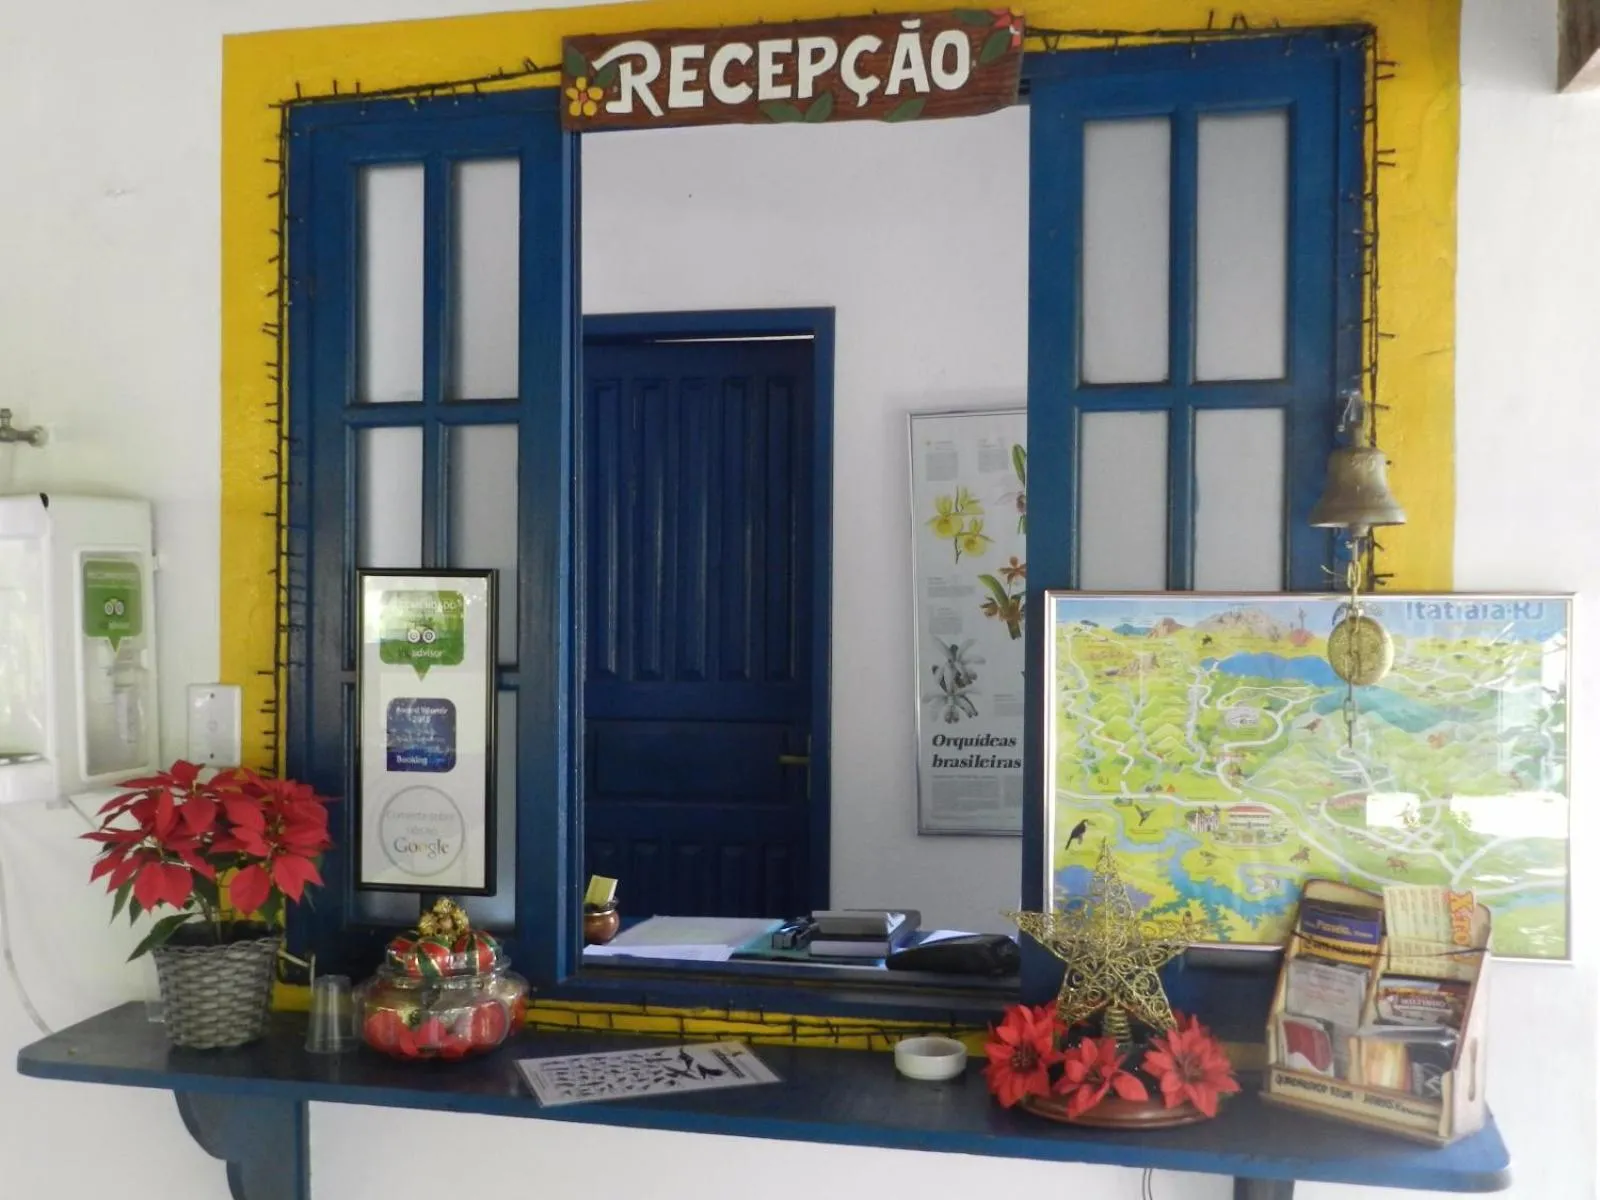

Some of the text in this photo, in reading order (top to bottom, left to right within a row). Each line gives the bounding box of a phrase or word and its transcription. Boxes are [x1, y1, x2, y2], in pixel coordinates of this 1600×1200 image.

[592, 18, 972, 117] RECEPÇÃO
[931, 734, 1017, 751] Orquídeas
[931, 754, 1022, 769] brasileiras
[393, 836, 449, 860] Google
